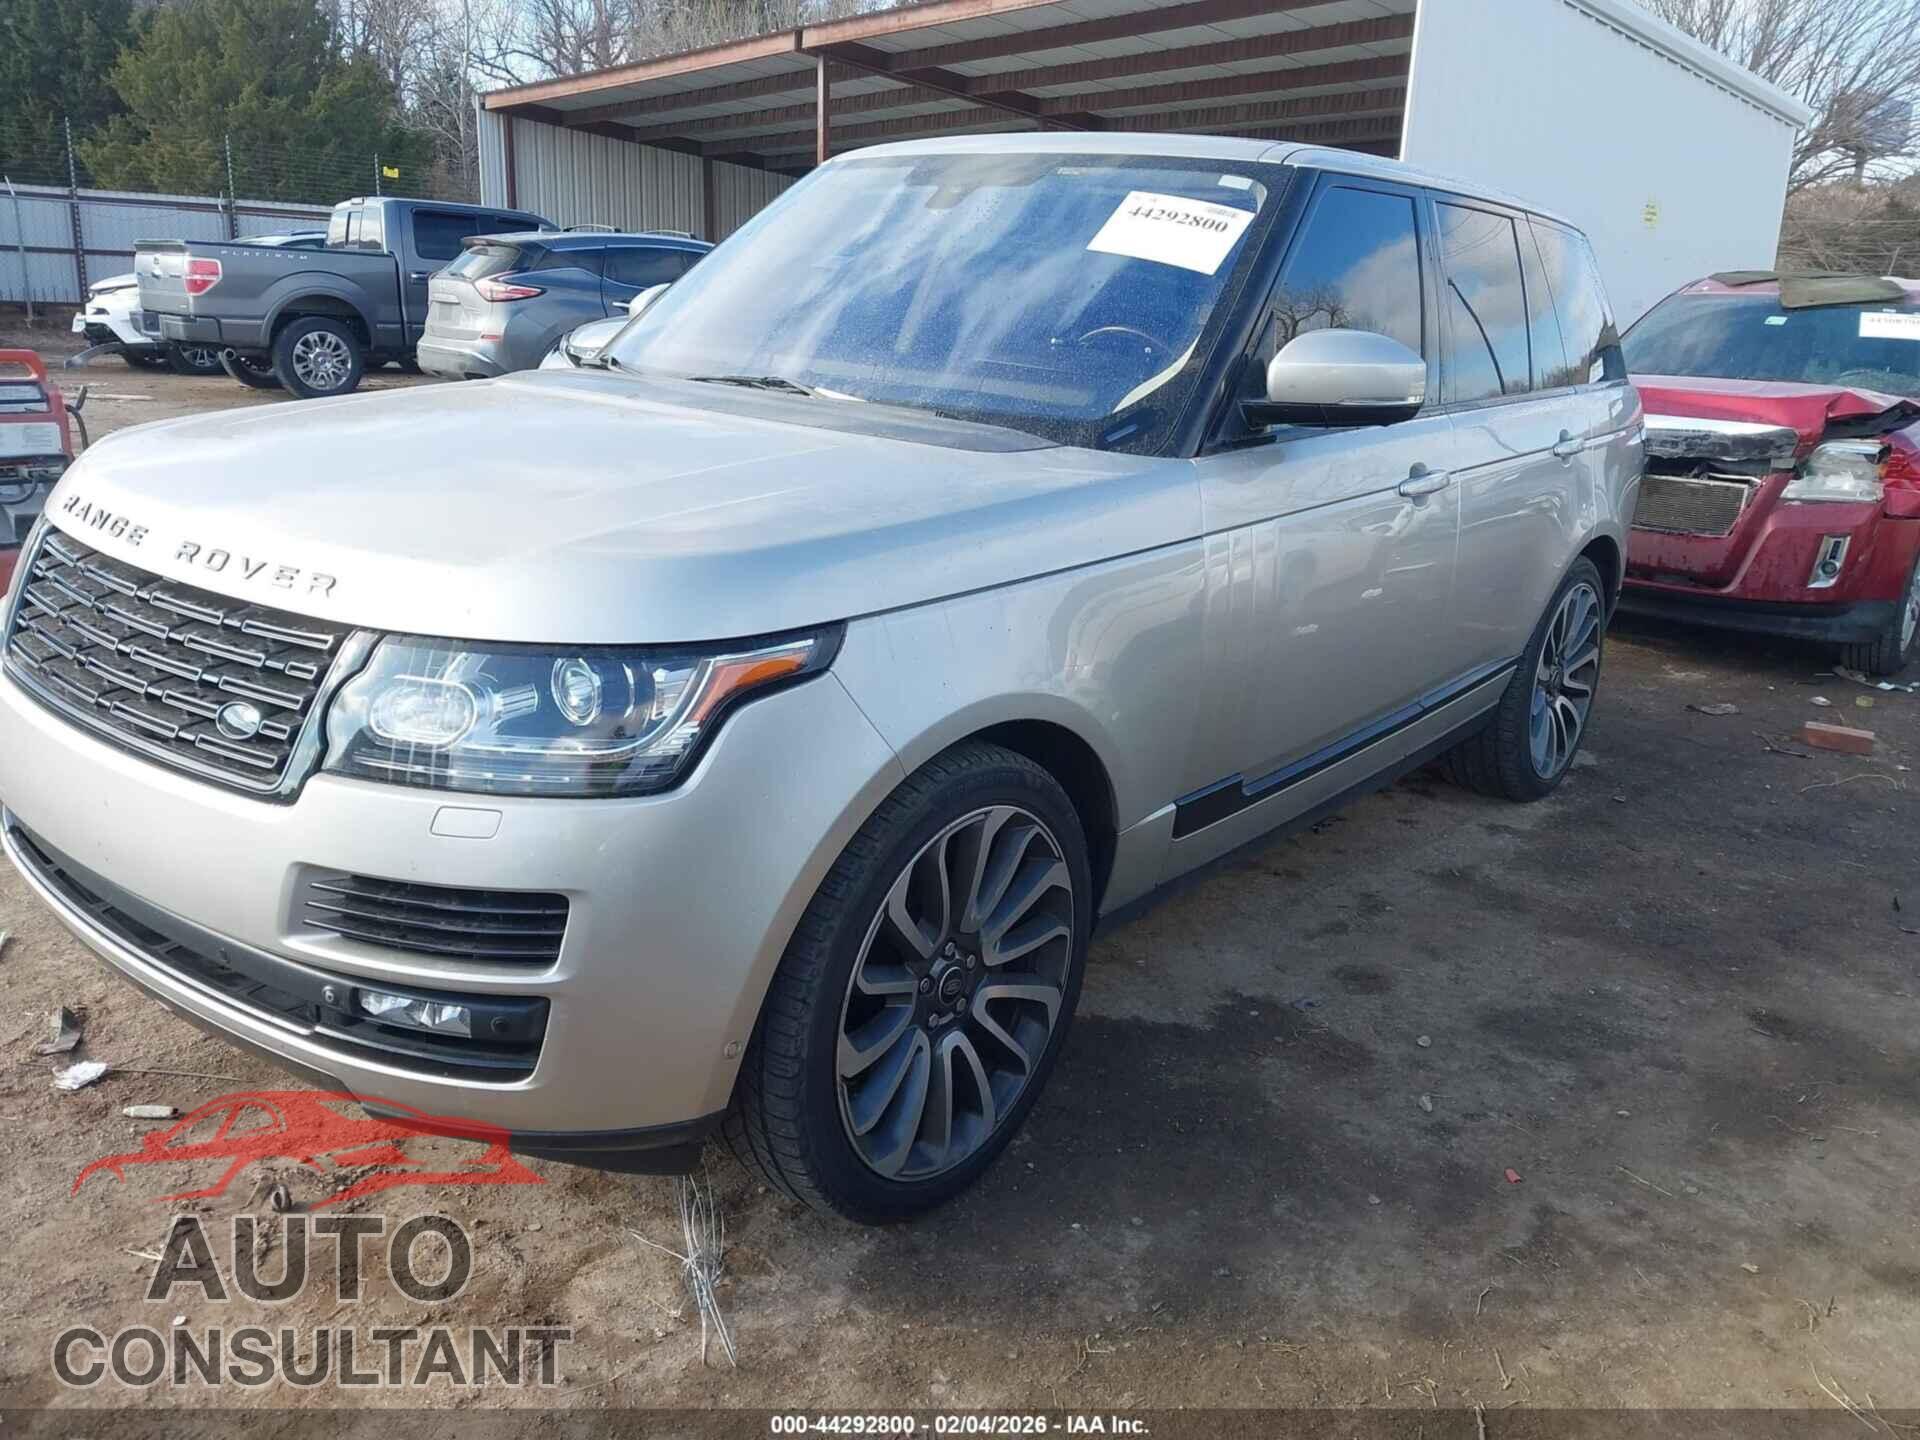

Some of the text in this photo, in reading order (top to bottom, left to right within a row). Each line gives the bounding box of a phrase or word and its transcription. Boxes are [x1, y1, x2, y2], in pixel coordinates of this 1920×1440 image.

[1128, 206, 1229, 233] 44292800
[62, 495, 337, 598] RANGE ROVER
